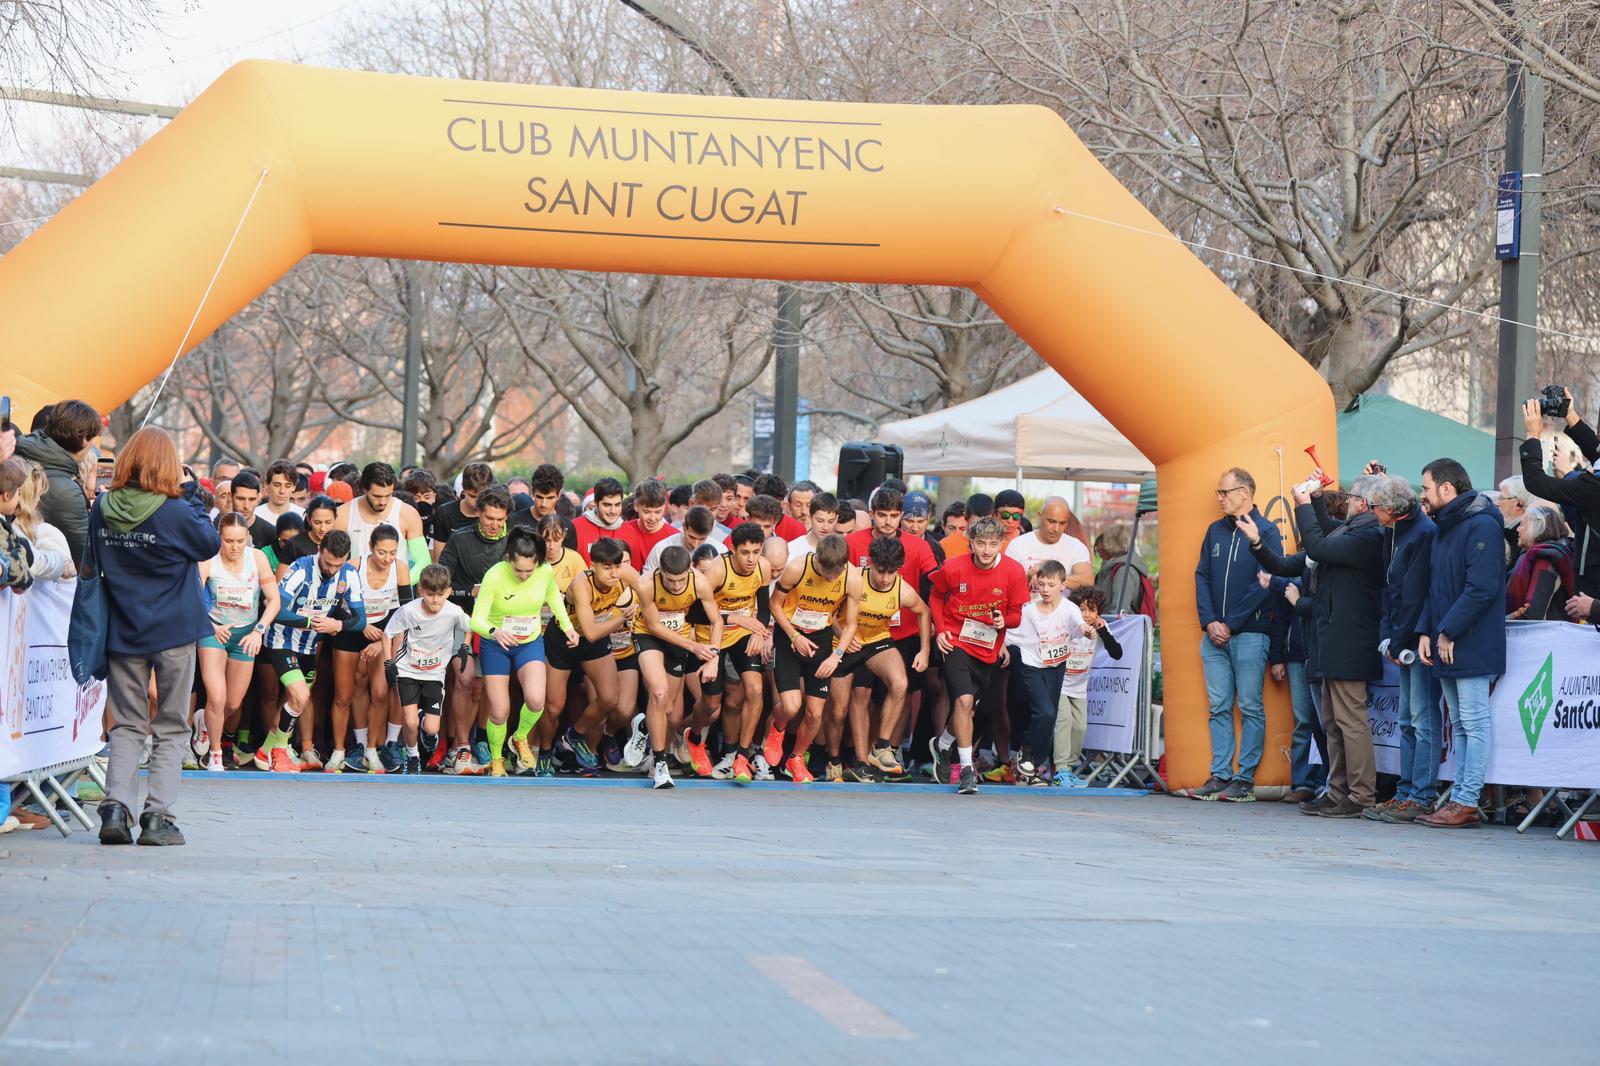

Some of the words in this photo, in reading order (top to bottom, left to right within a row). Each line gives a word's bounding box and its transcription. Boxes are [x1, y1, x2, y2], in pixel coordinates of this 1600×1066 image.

[447, 117, 552, 156] CLUB
[568, 124, 884, 173] MUNTANYENC
[524, 176, 643, 218] SANT
[656, 184, 807, 225] CUGAT
[417, 657, 439, 666] 1353
[1048, 645, 1068, 658] 1259
